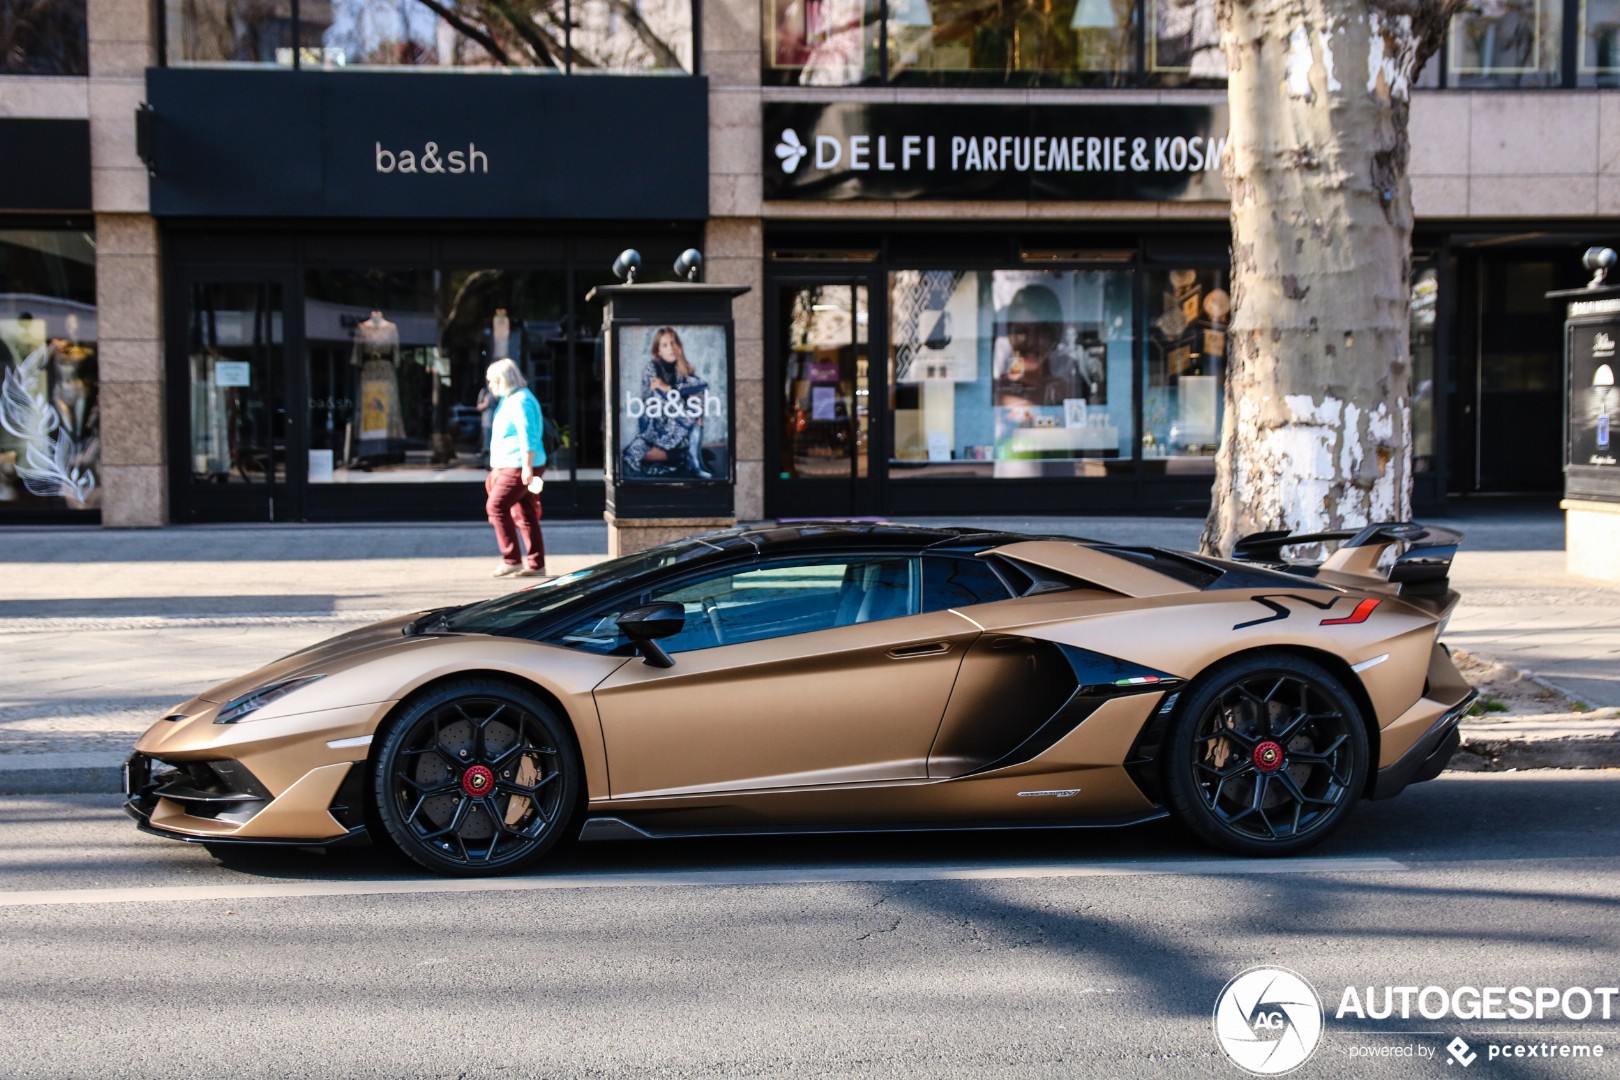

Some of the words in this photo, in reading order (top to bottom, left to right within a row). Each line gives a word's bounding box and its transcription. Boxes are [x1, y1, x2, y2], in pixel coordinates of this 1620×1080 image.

[376, 141, 488, 174] ba&sh
[815, 135, 935, 171] DELFI
[625, 389, 722, 418] ba&sh
